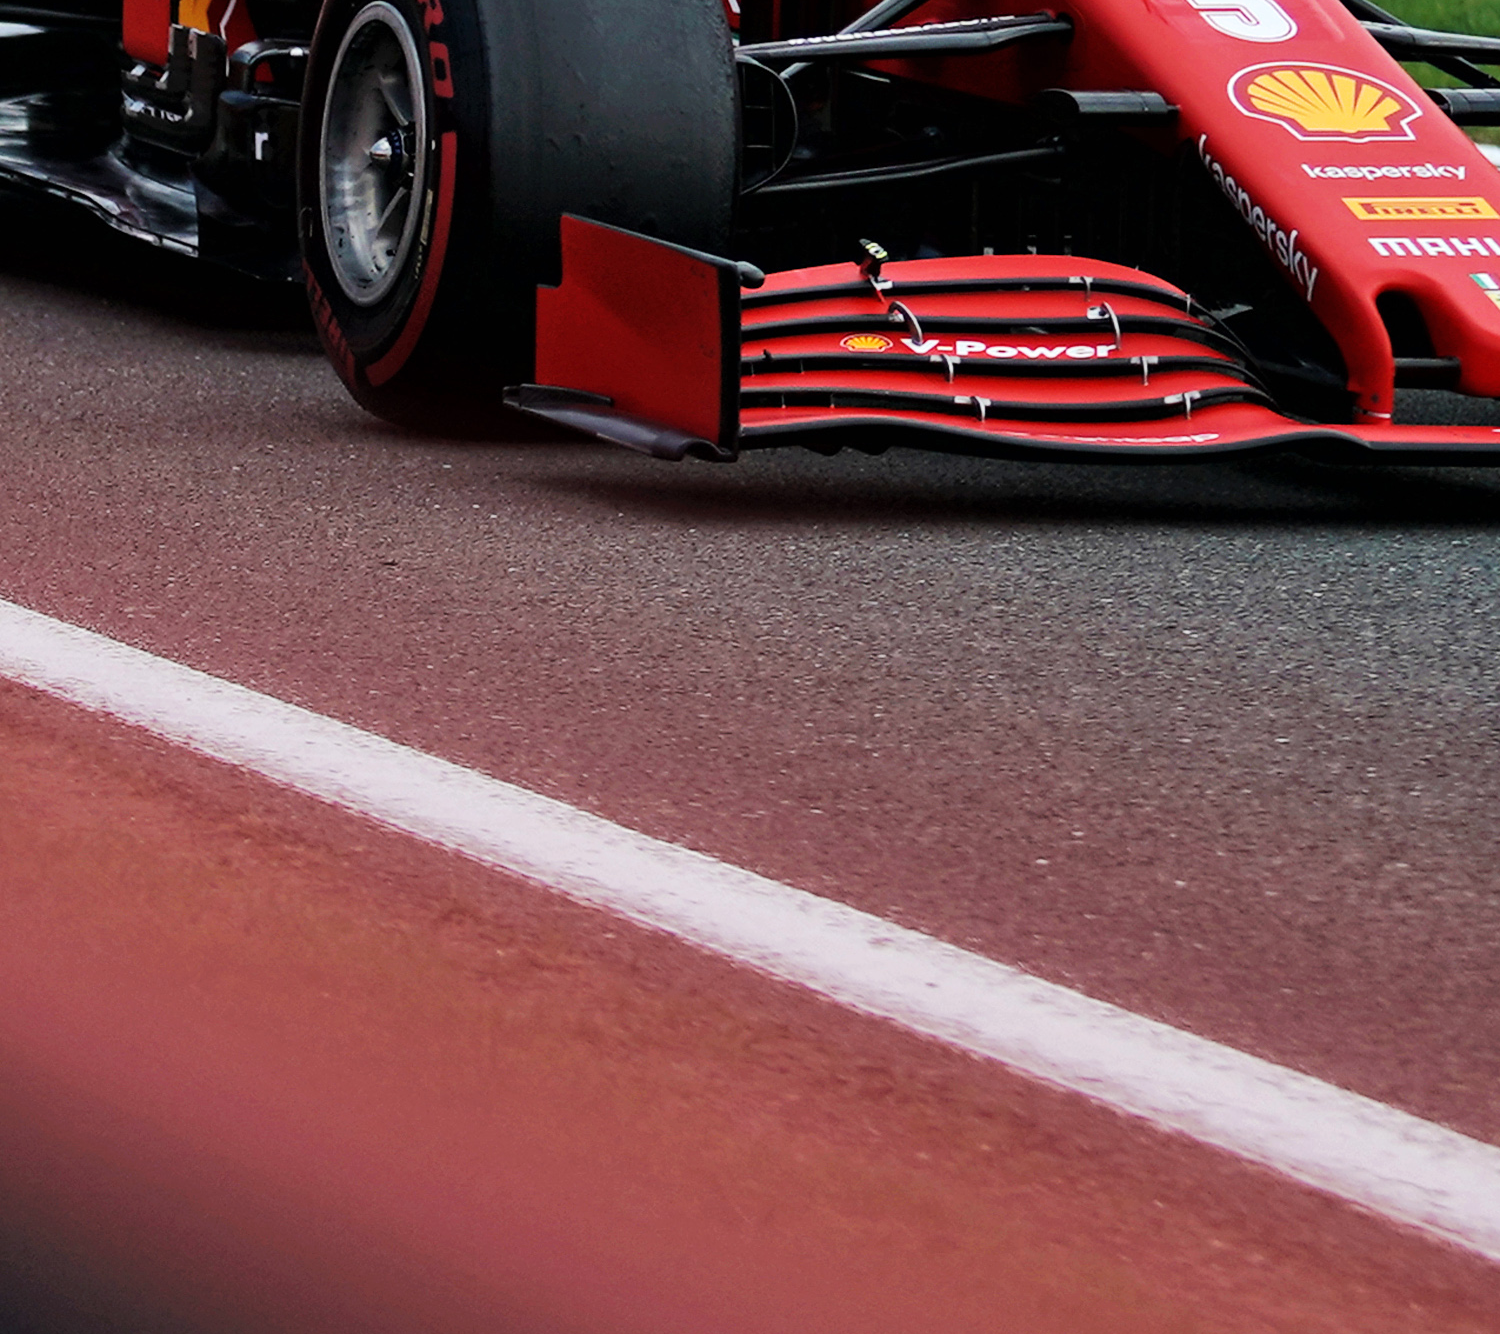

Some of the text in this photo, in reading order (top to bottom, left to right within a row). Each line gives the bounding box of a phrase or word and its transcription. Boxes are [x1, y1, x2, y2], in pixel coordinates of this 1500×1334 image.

[1300, 163, 1467, 181] kaspersky
[1358, 202, 1484, 216] PIRELLI
[901, 338, 1117, 359] V-Power
